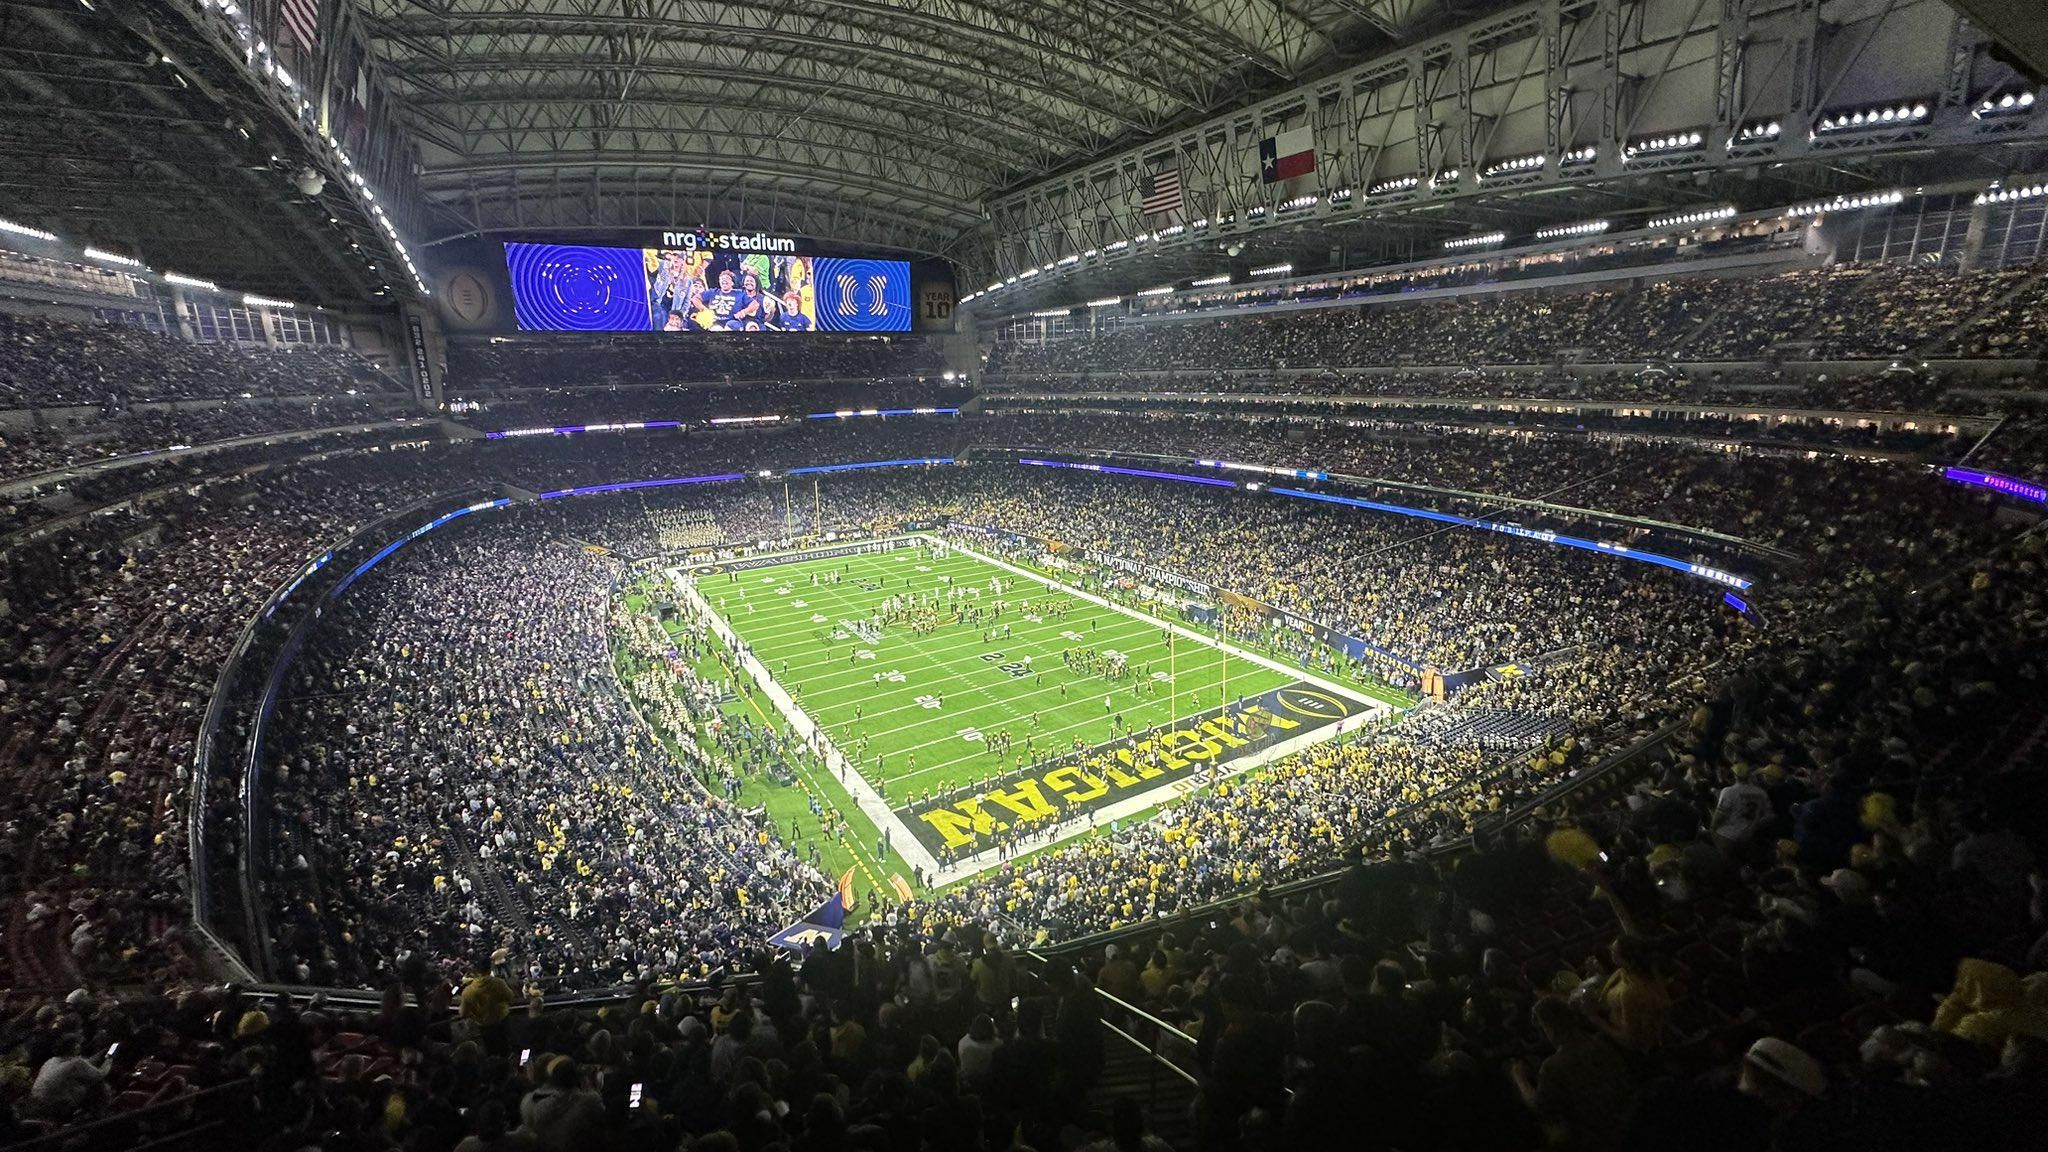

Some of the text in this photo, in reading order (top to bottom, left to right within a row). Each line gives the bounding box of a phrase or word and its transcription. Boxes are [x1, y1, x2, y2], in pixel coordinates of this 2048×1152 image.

[663, 231, 795, 251] nrg stadium
[925, 292, 951, 301] YEAR
[926, 302, 951, 320] 10
[1103, 555, 1143, 576] NATIONAL
[919, 704, 1301, 850] MICHIGAN
